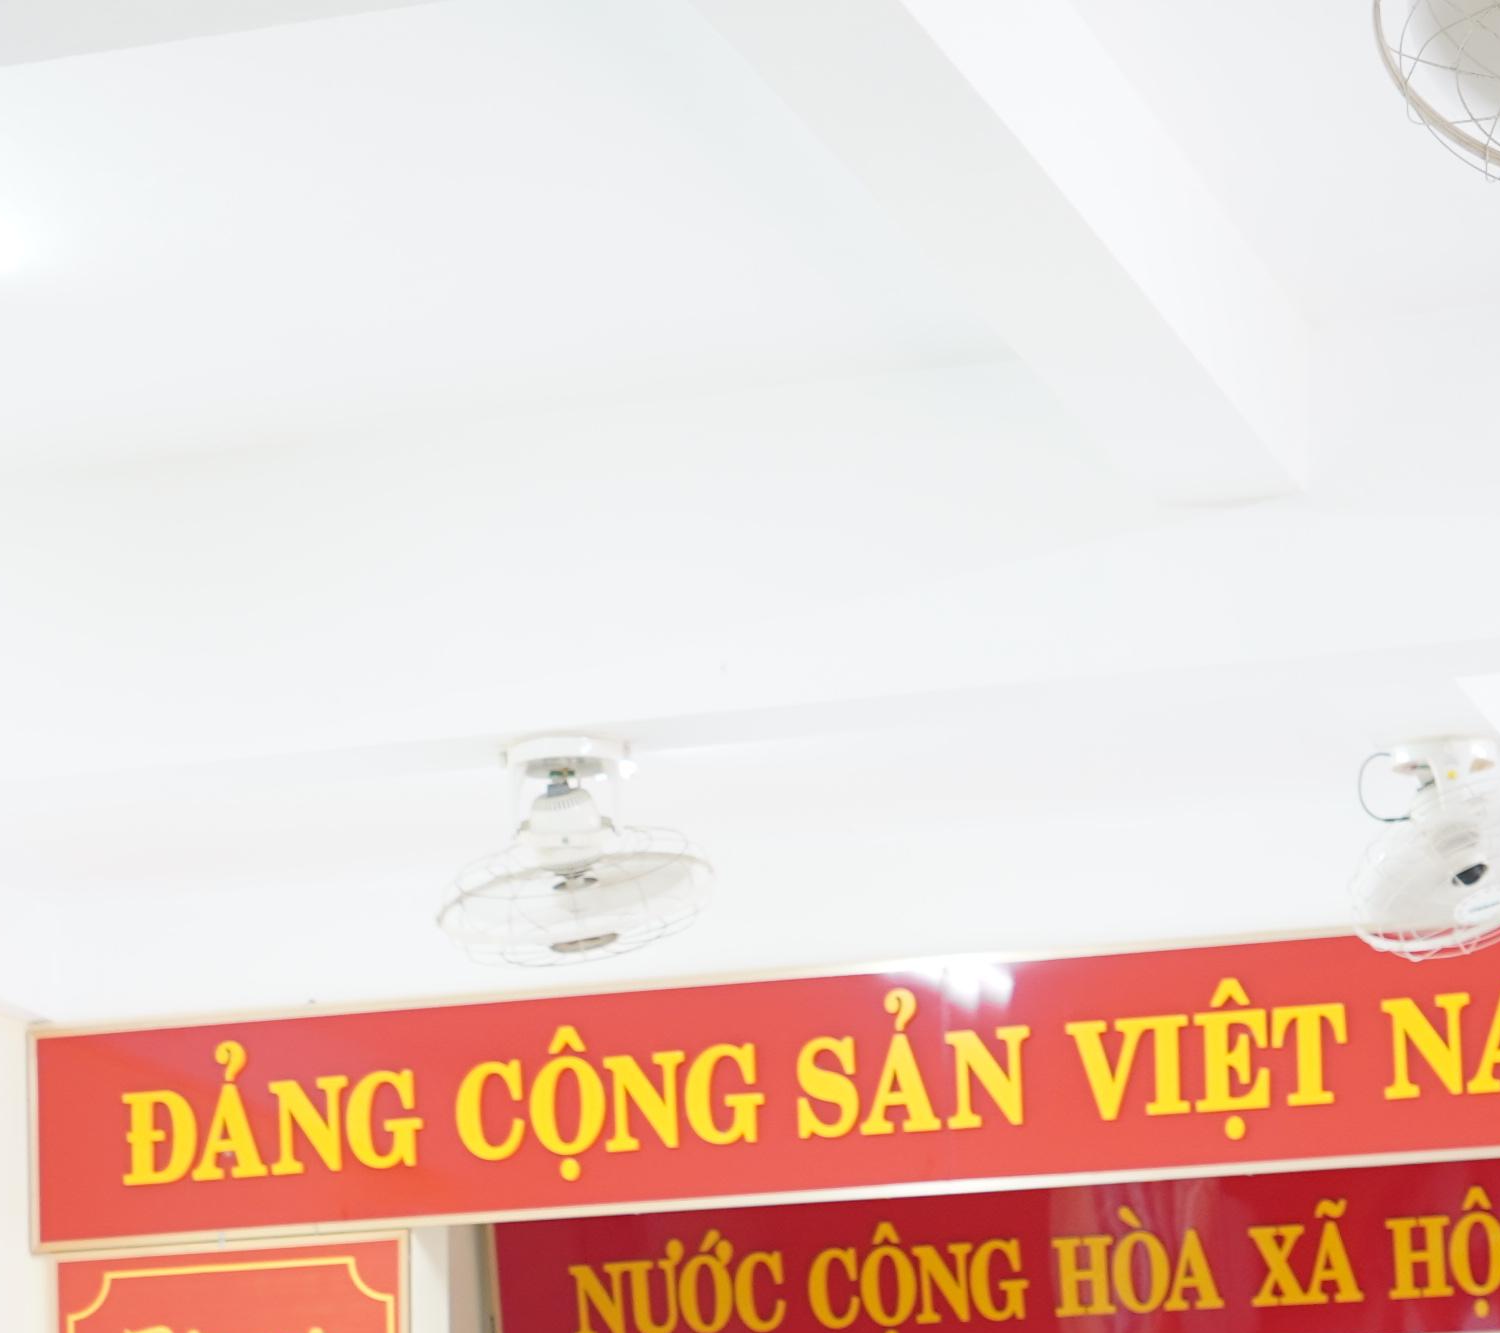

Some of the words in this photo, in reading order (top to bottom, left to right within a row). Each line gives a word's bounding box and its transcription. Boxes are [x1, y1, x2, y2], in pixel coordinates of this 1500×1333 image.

[122, 1041, 423, 1186] ĐẢNG
[455, 1026, 765, 1181] CỘNG
[797, 991, 1030, 1139] SẢN
[1066, 978, 1347, 1140] VIỆT
[1053, 1204, 1224, 1317] HÒA
[1250, 1200, 1363, 1306] XÃ
